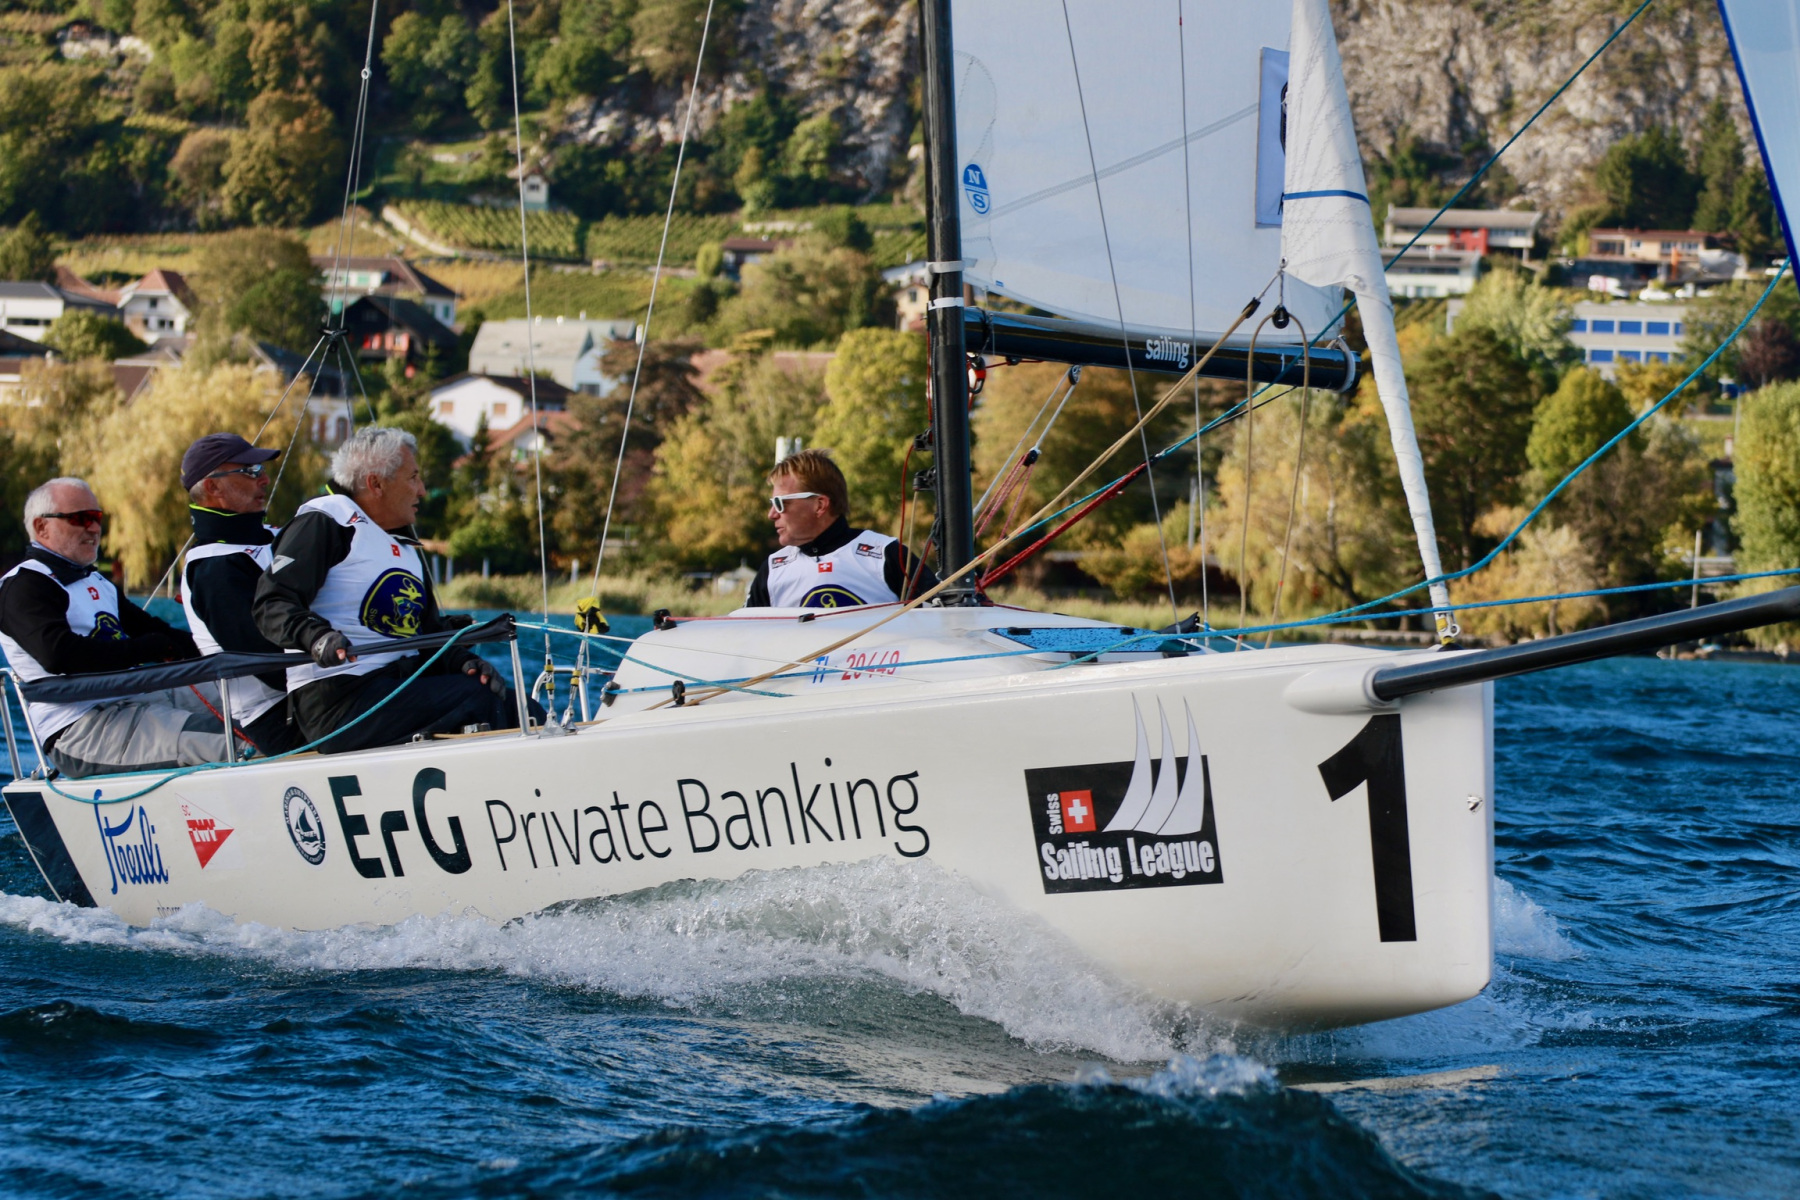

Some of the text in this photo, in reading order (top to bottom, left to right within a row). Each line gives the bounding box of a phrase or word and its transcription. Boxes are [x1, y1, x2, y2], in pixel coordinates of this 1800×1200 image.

[968, 169, 981, 185] N
[973, 193, 986, 209] S
[1145, 335, 1190, 369] sailing
[328, 757, 930, 878] ErG Private Banking
[1047, 793, 1063, 835] swiss
[1317, 713, 1417, 942] 1
[1041, 837, 1216, 883] Sailing League
